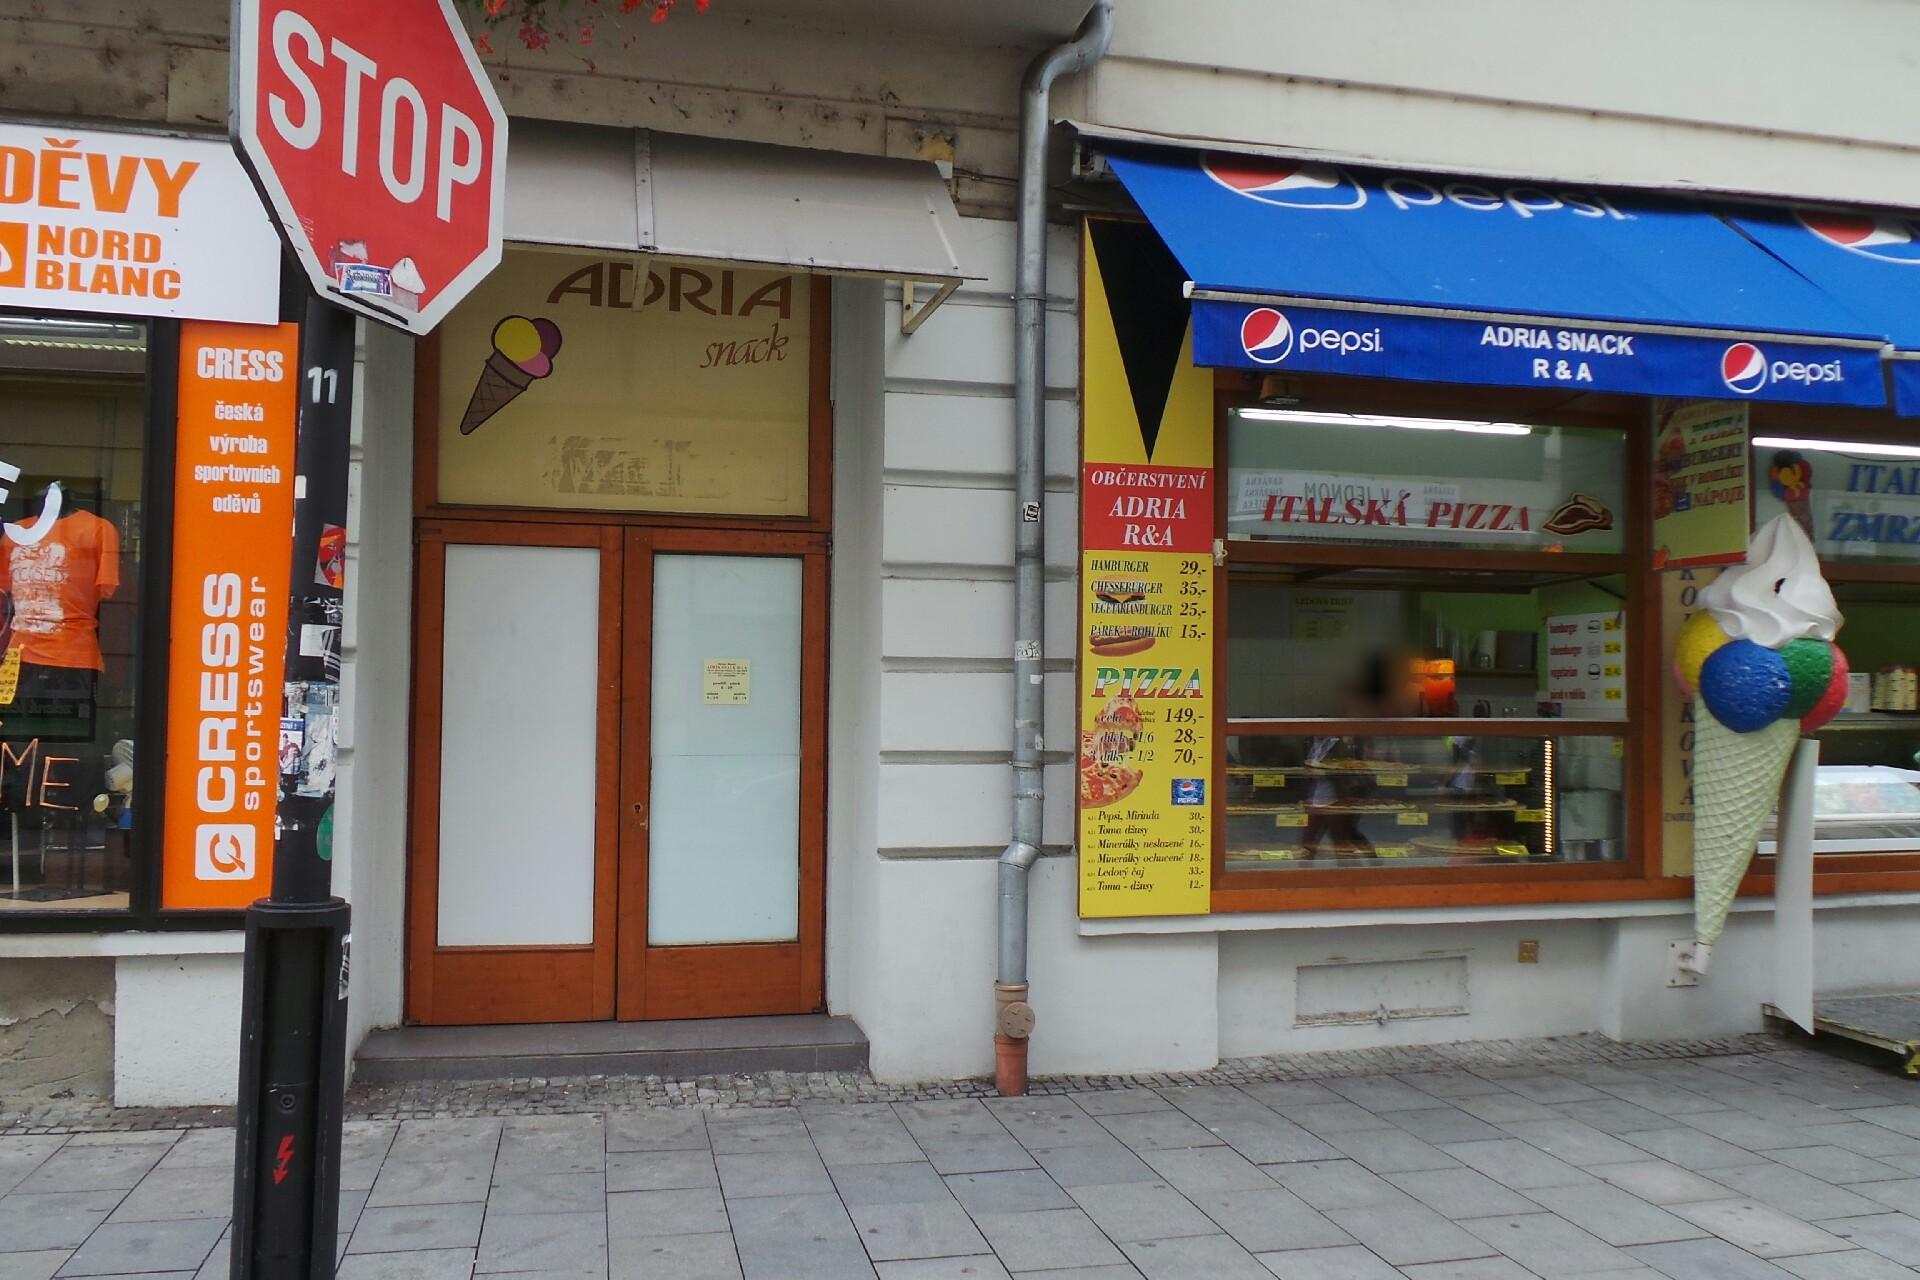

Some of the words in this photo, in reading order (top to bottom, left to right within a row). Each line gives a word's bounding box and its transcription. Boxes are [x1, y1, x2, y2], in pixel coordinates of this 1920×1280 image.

[269, 9, 482, 223] STOP
[0, 137, 200, 218] DĚVY
[1382, 177, 1627, 220] pepsi
[37, 224, 161, 263] NORD
[35, 259, 181, 299] BLANC
[546, 262, 792, 319] ADRIA
[699, 323, 789, 368] snack
[1300, 327, 1382, 356] pepsi
[1480, 325, 1552, 350] ADRIA
[1555, 330, 1635, 356] SNACK
[197, 347, 284, 382] CRESS
[1533, 358, 1550, 378] R
[1554, 360, 1573, 380] &
[1576, 362, 1593, 381] A
[1771, 360, 1842, 386] pepsi
[308, 367, 338, 403] 11
[214, 400, 264, 421] česká
[210, 434, 268, 455] výroba
[195, 464, 280, 483] sportovních
[1091, 467, 1206, 489] OBČERSTVENÍ
[213, 493, 261, 513] oděvů
[1109, 496, 1187, 519] ADRIA
[1262, 492, 1412, 527] ITALSKÁ
[1427, 502, 1529, 532] PIZZA
[1122, 524, 1173, 546] R&A
[1090, 560, 1149, 572] HAMBURGER
[197, 572, 242, 812] CRESS
[245, 576, 267, 810] sportswear
[1091, 667, 1204, 699] PIZZA
[1165, 707, 1205, 724] 149,-
[1174, 729, 1205, 744] 28,-
[1174, 749, 1205, 765] 70,-
[1126, 810, 1160, 820] Mirinda
[1098, 825, 1122, 835] Toma
[1125, 825, 1149, 837] džusy
[1098, 839, 1140, 850] Minerálky
[1098, 853, 1140, 865] Minerálky
[1098, 867, 1128, 879] Ledový
[1131, 867, 1145, 878] čaj
[1097, 881, 1120, 891] Toma
[1130, 881, 1154, 893] džusy
